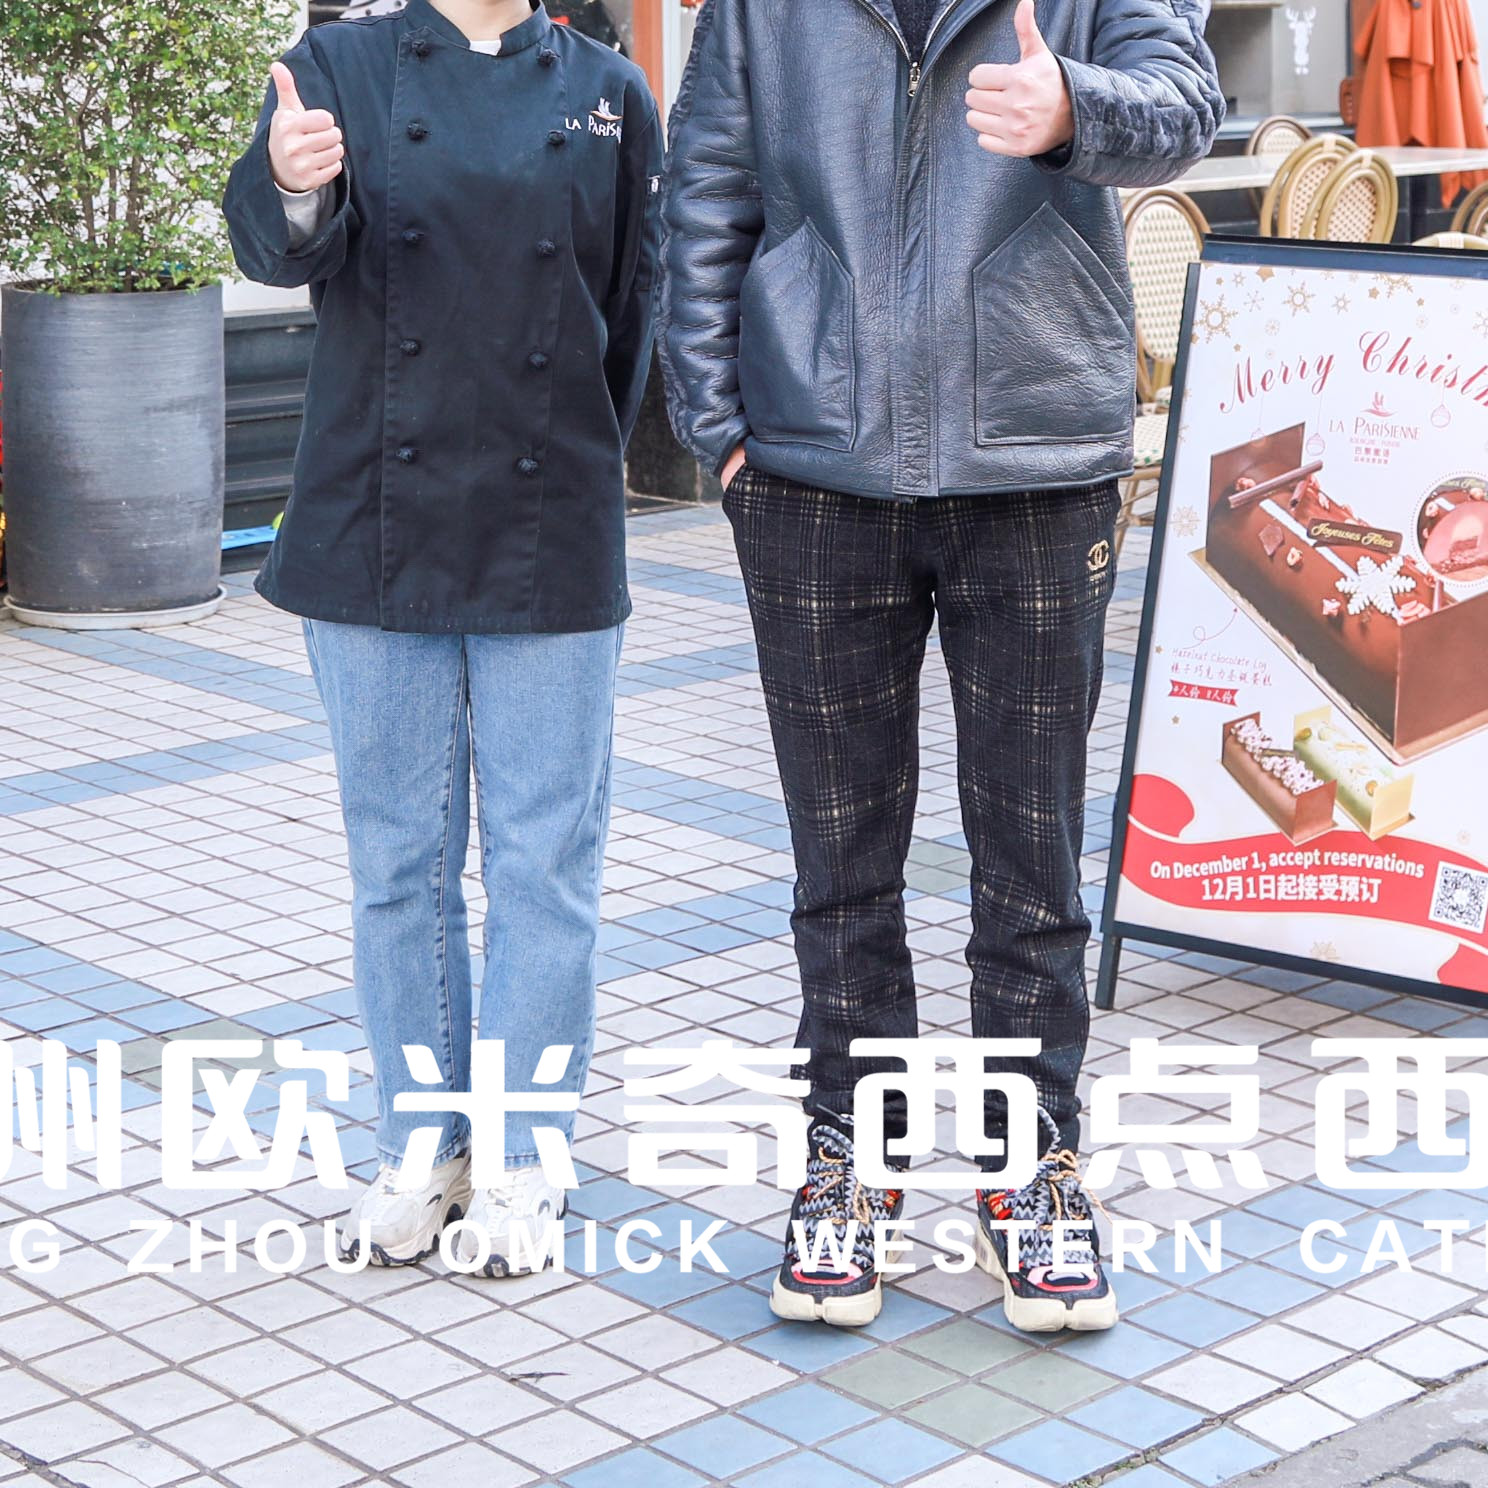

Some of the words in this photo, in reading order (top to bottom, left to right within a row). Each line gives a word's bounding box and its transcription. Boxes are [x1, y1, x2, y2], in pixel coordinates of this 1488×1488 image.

[564, 117, 582, 131] LA
[1218, 352, 1336, 415] Merry
[1328, 418, 1345, 433] LA
[1149, 861, 1172, 879] On
[1172, 854, 1250, 880] December
[1251, 851, 1267, 871] 1,
[1268, 848, 1321, 870] accept
[1323, 849, 1426, 879] reservations
[1201, 874, 1383, 904] 12月1日起接受预订
